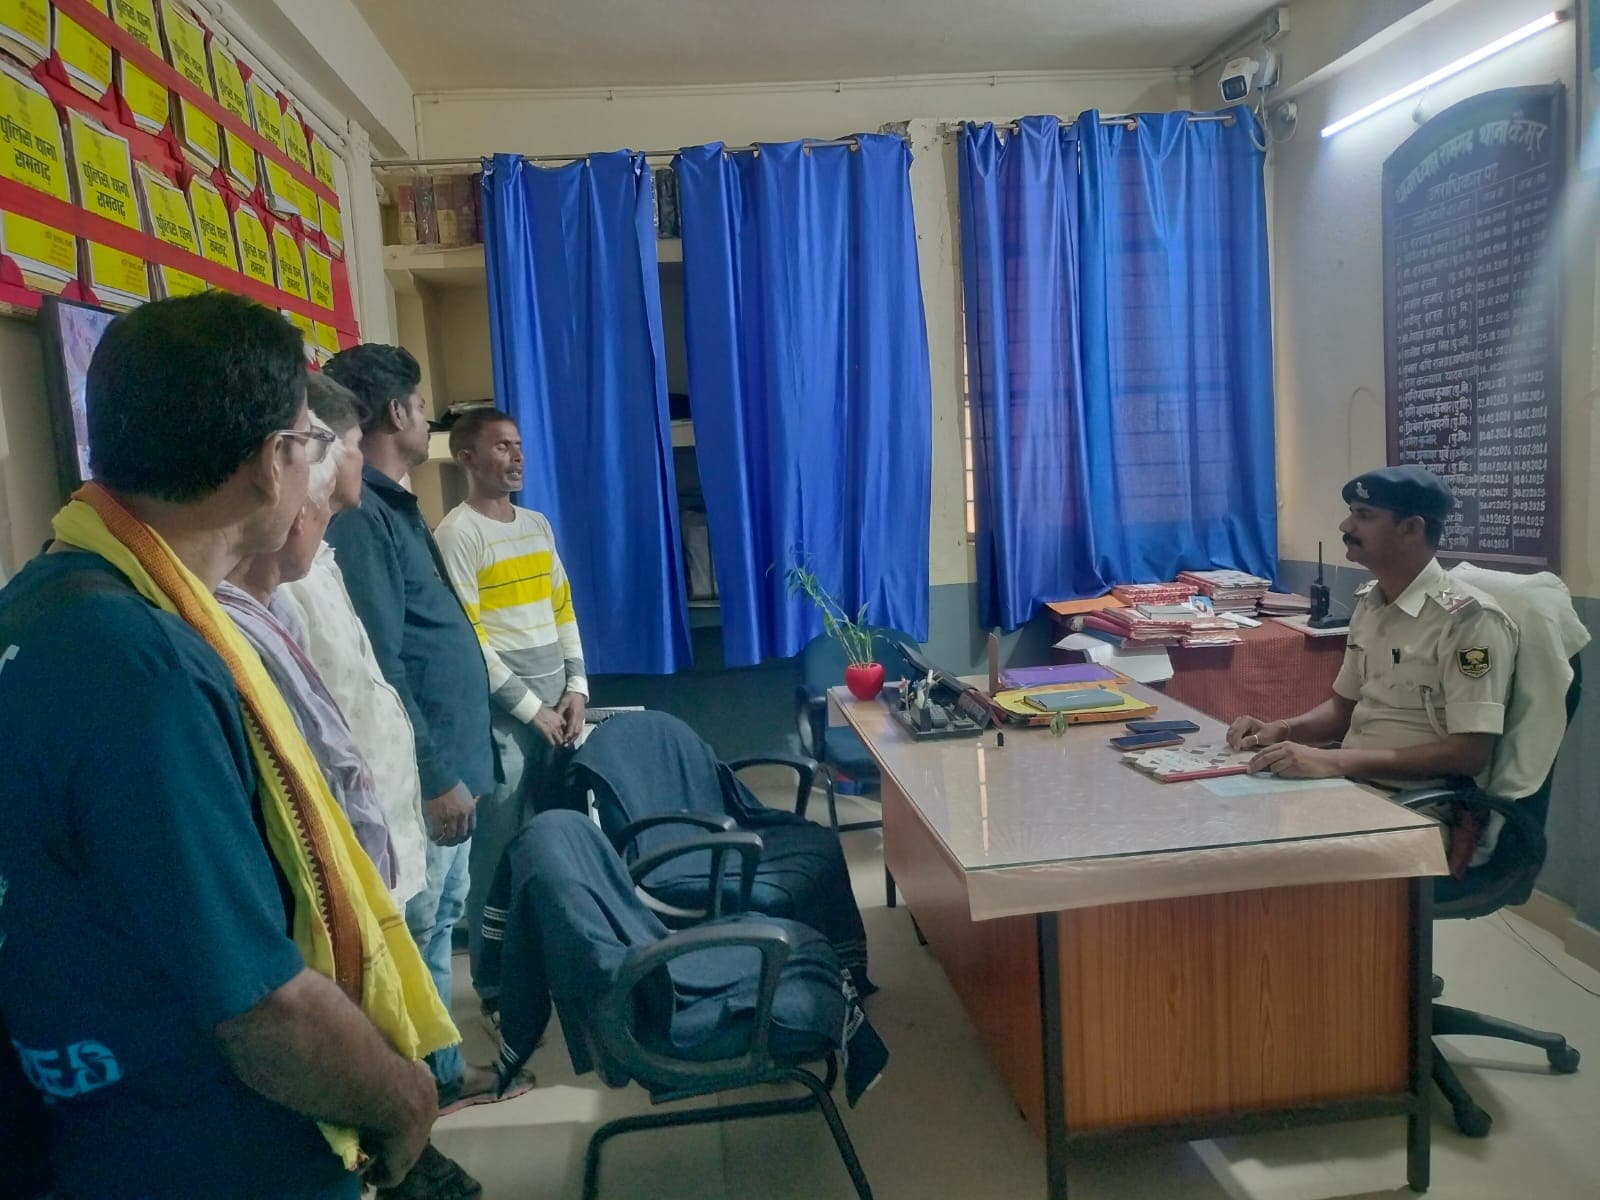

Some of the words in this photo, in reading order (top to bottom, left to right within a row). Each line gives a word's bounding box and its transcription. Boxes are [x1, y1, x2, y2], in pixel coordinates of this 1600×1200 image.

[35, 135, 58, 162] थाना
[82, 160, 110, 189] पुलिस
[110, 176, 130, 199] थाना
